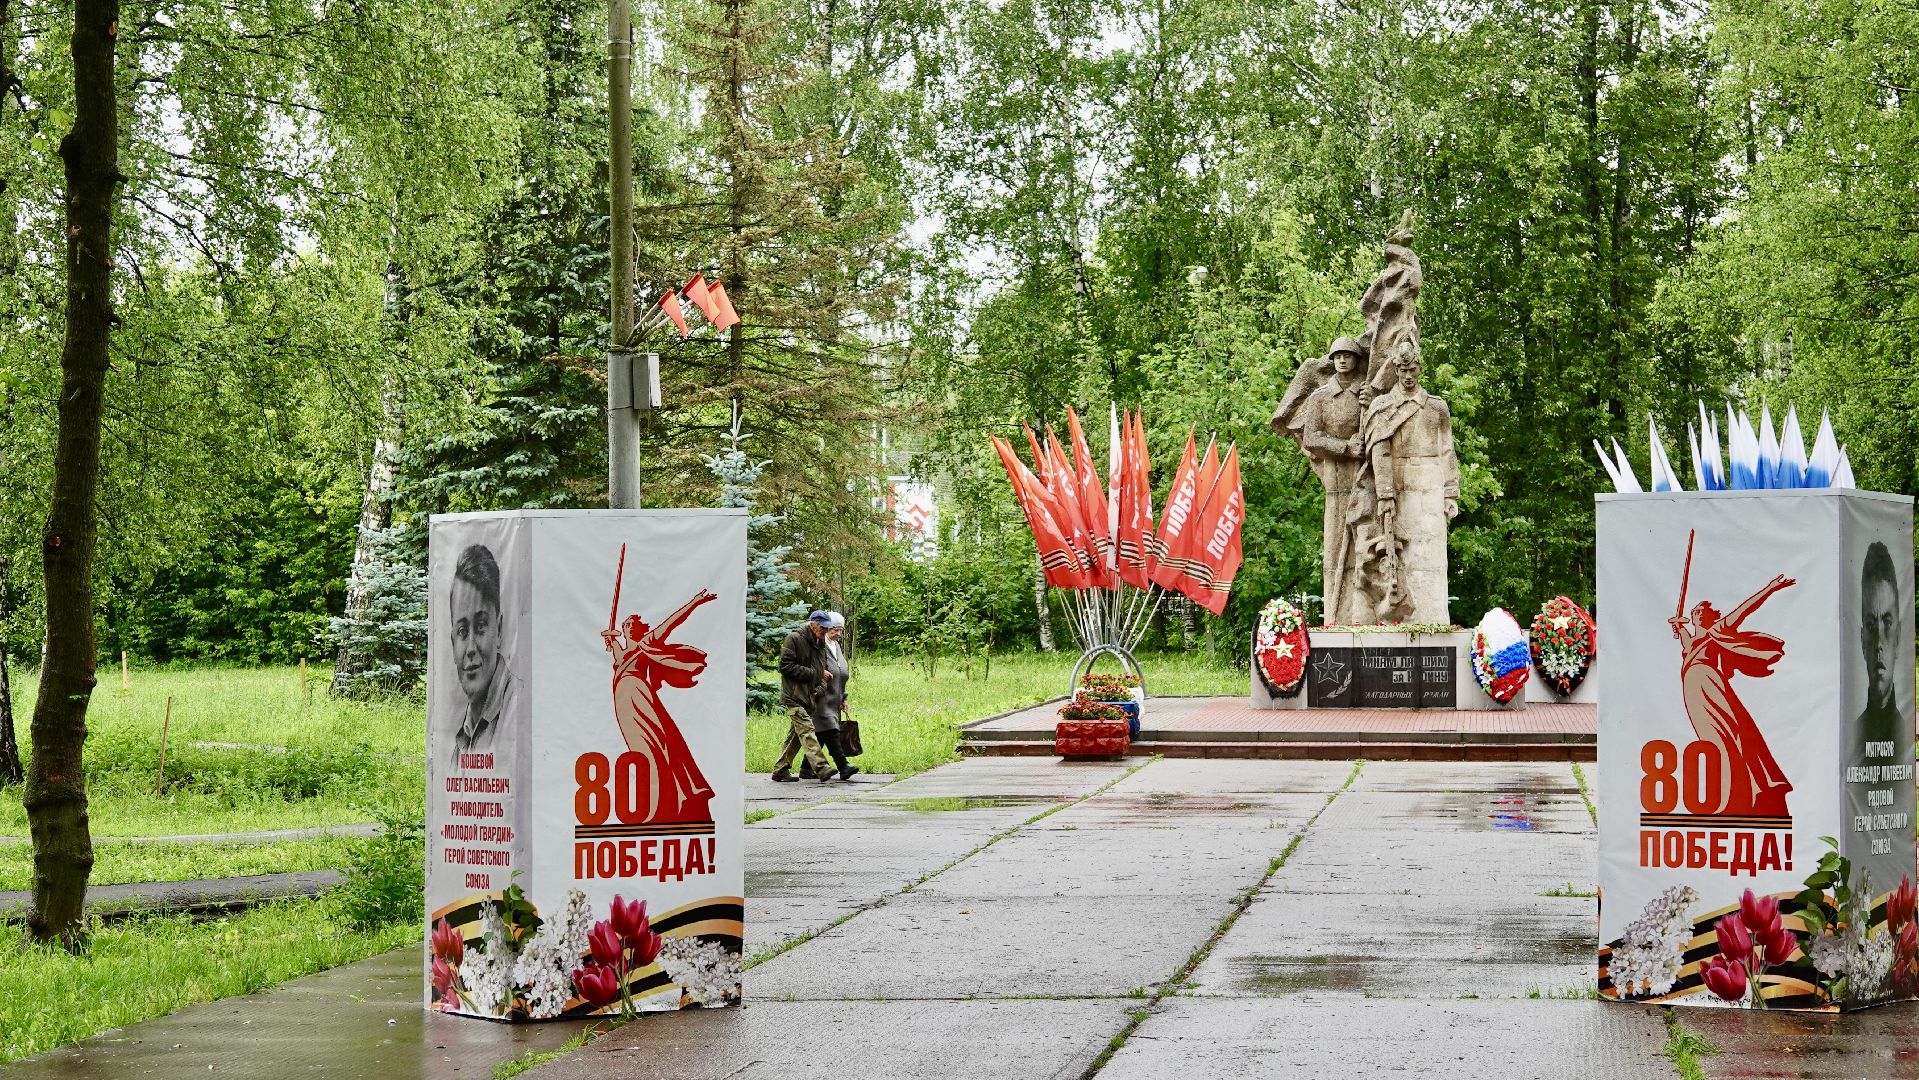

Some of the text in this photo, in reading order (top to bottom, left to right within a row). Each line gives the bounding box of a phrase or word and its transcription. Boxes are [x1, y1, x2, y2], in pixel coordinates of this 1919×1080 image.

[460, 752, 494, 769] КОШЕВОЙ
[446, 777, 510, 794] ОЛЕГ ВАСИЛЬЕВИЧ
[1640, 739, 1722, 814] 80
[574, 751, 651, 825] 80
[1867, 788, 1894, 808] РЯДОВОЙ
[451, 801, 504, 819] РУКОВОДИТЕЛЬ
[1854, 813, 1908, 832] ГЕРОЙ СОВЕТСКОГО
[440, 823, 478, 842] «МОЛОДОЙ
[1639, 830, 1793, 877] ПОБЕДА!
[1871, 838, 1892, 855] СОЮЗА
[444, 847, 510, 866] ГЕРОЙ СОВЕТСКОГО
[574, 838, 716, 882] ПОБЕДА!
[465, 873, 490, 889] СОЮЗА
